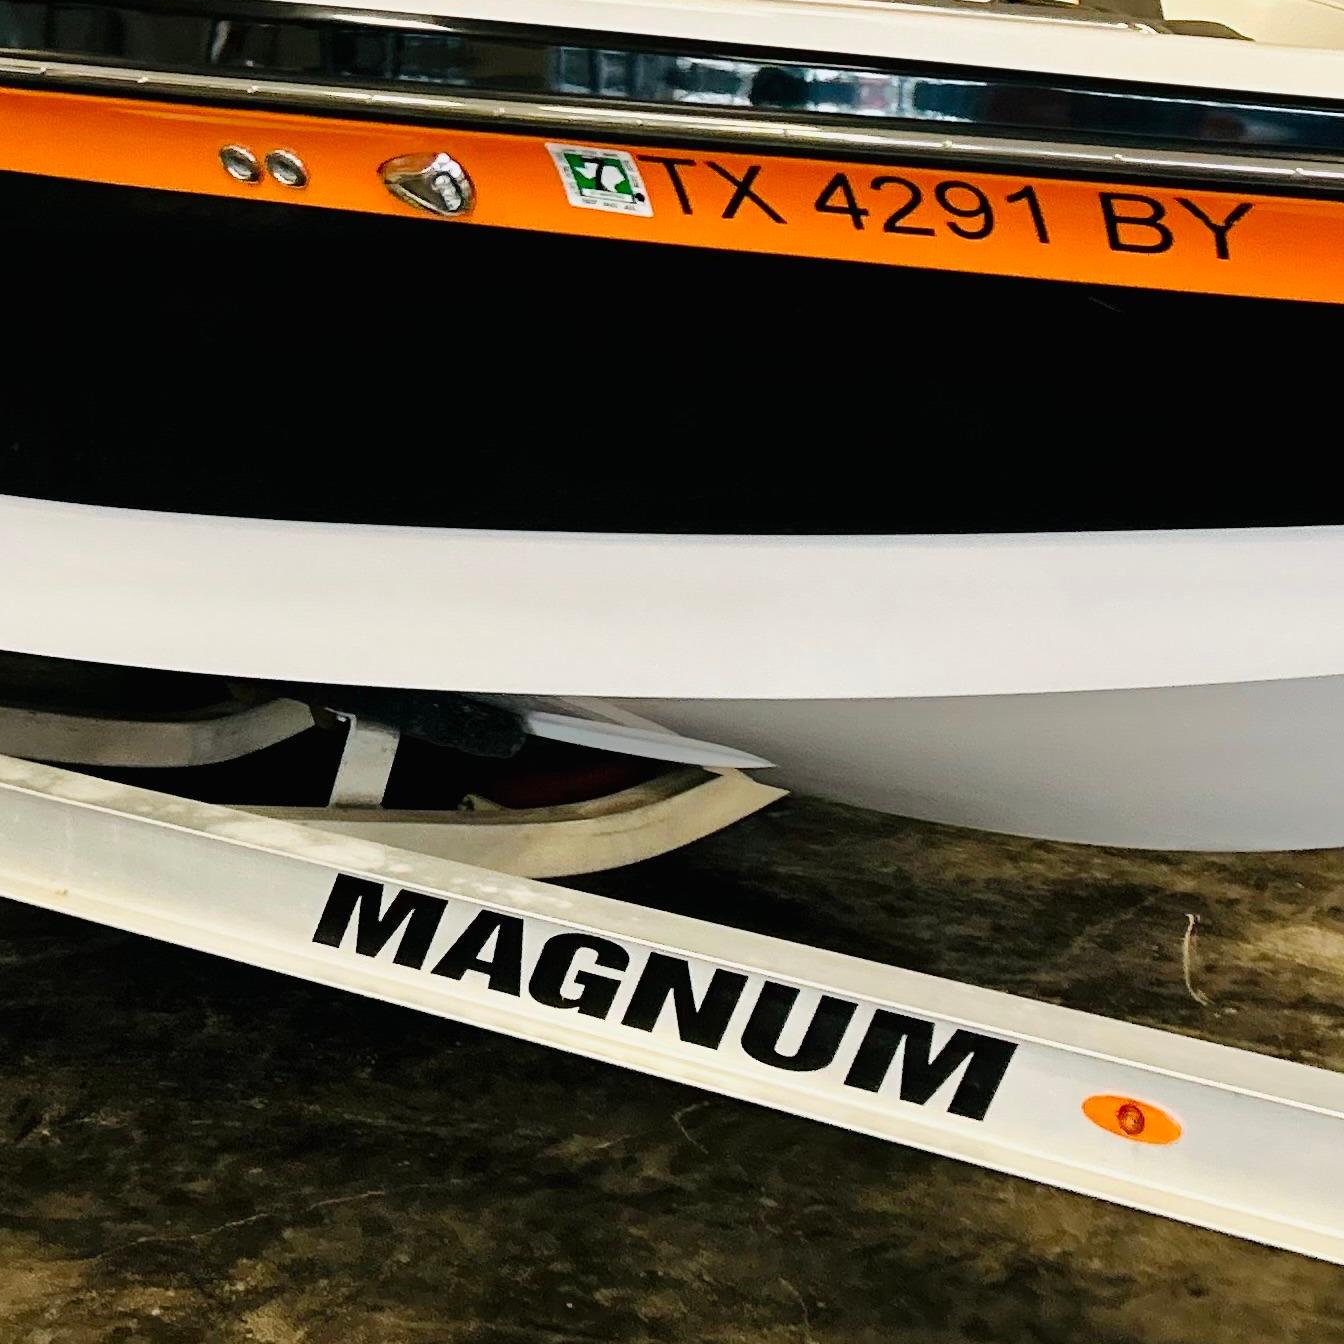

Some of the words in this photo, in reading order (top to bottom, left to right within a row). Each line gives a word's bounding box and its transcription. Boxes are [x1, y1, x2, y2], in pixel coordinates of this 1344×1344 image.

[636, 153, 788, 225] TX
[814, 171, 1050, 245] 4291
[1098, 191, 1254, 260] BY
[311, 872, 1020, 1122] MAGNUM
